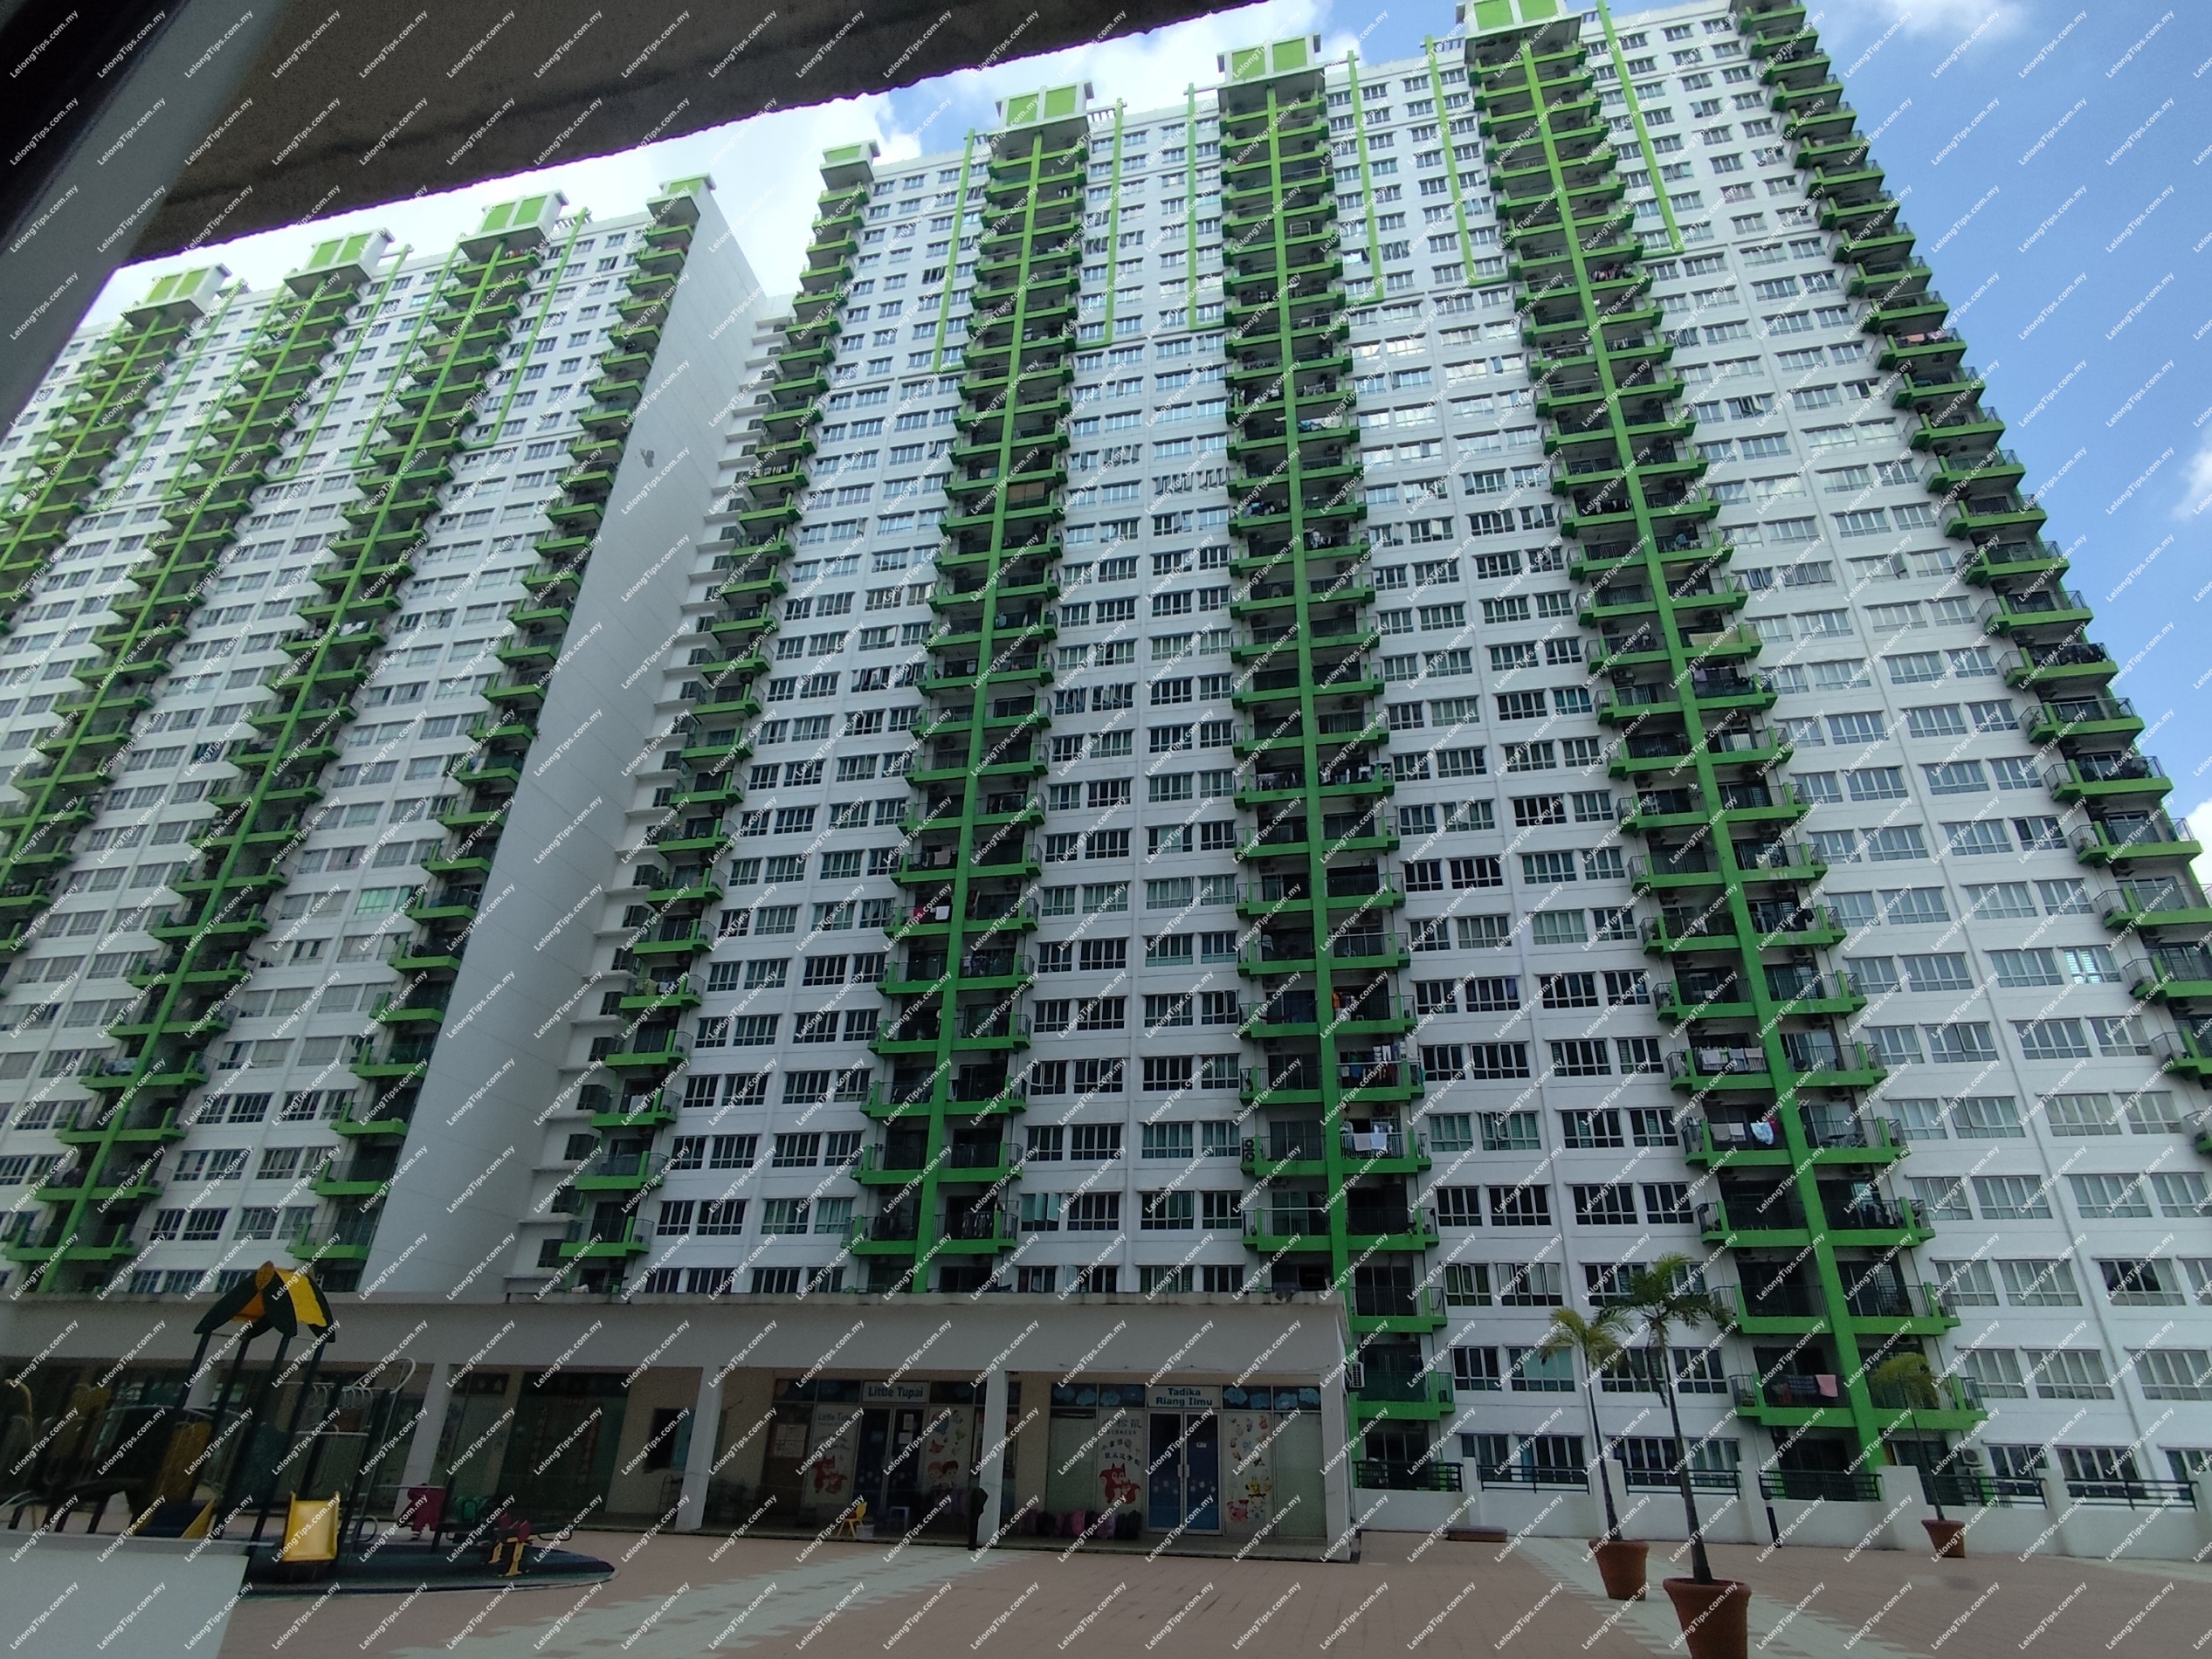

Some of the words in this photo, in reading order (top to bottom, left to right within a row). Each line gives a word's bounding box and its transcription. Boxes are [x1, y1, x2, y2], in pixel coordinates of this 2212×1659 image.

[868, 1386, 893, 1397] Little
[898, 1386, 924, 1400] Tupai
[1168, 1387, 1201, 1396] Tadika
[1156, 1397, 1185, 1407] Riang
[1189, 1397, 1213, 1406] Ilmu
